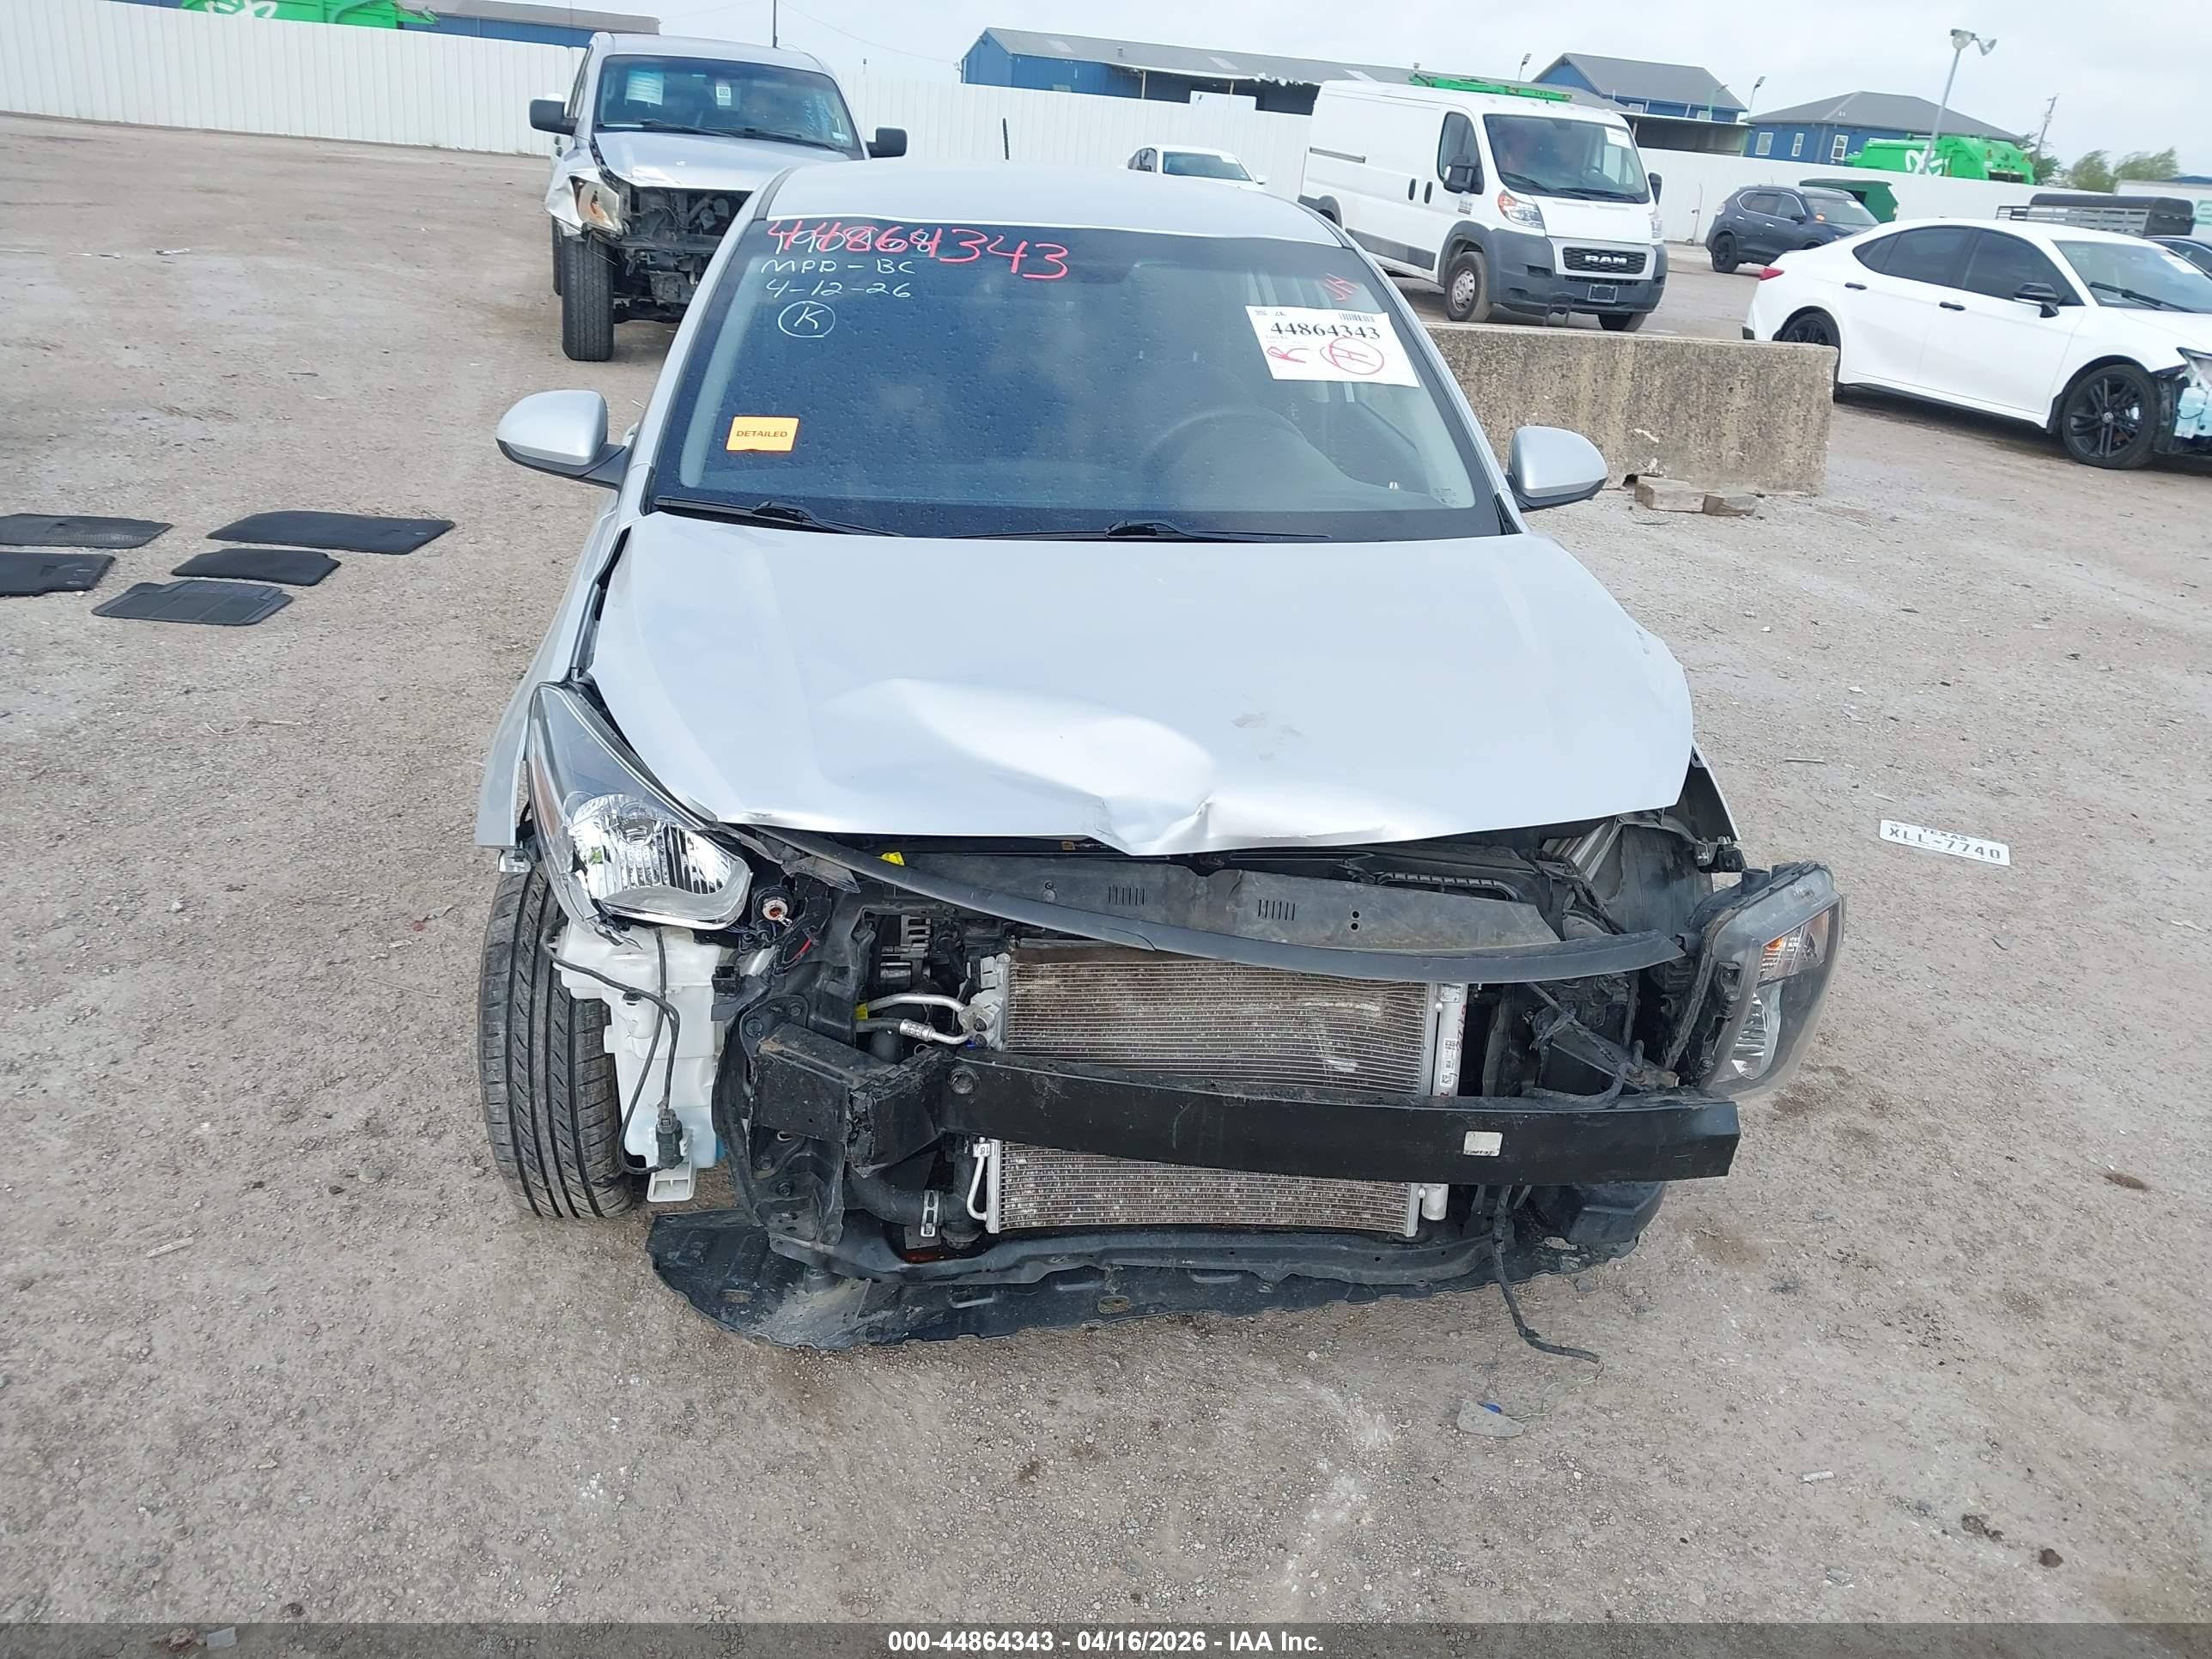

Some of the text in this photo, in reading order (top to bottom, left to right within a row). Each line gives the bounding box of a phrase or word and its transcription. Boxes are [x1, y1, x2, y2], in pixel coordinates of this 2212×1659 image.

[876, 258, 916, 274] BC
[1584, 255, 1627, 264] RAM
[766, 279, 911, 298] 4-12-26
[1271, 323, 1380, 340] 44864343
[1922, 828, 1968, 842] TEXAS
